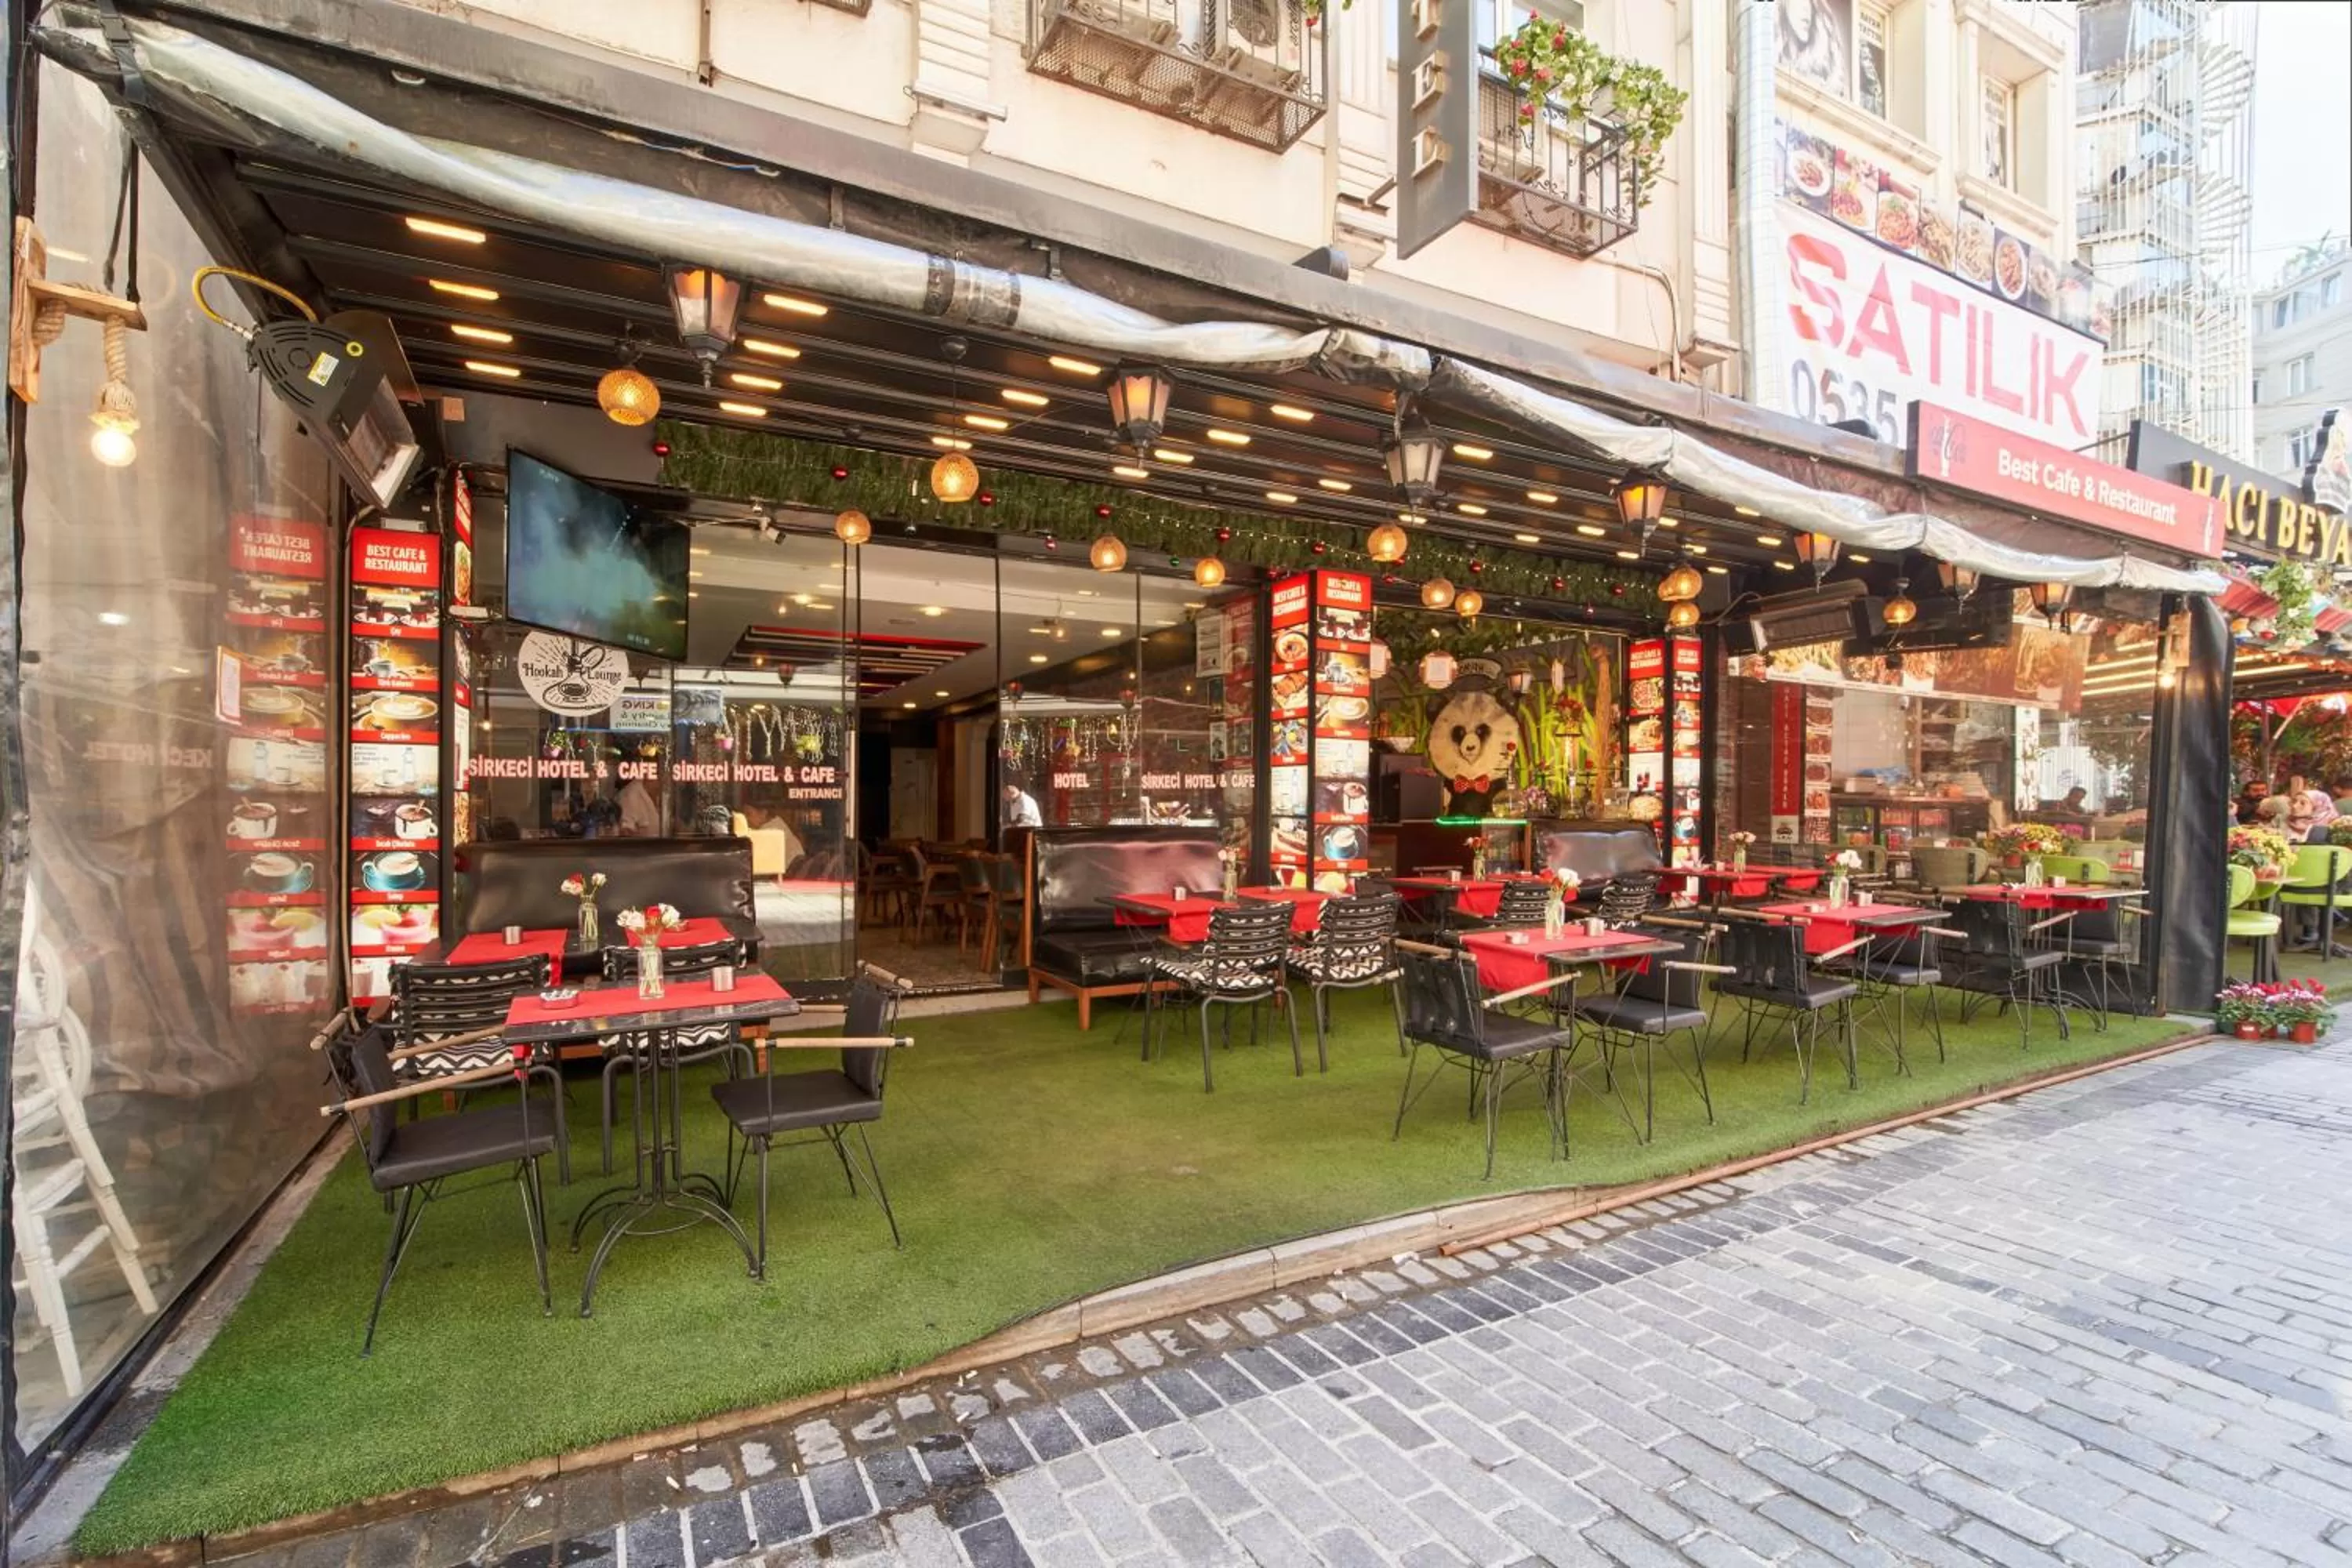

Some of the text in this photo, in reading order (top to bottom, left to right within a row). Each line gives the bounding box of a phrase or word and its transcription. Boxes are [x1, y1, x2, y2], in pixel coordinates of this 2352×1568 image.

[1787, 233, 2090, 437] SATILIK
[1791, 359, 1900, 448] 0535
[1998, 448, 2038, 485] Best
[2042, 464, 2081, 497] Cafe
[2084, 477, 2096, 503] &
[2098, 481, 2176, 526] Restaurant
[2192, 459, 2269, 540] HACI
[366, 544, 426, 561] BEST CAFE &
[364, 558, 428, 575] RESTAURANT
[521, 663, 622, 685] Hookah Lounge
[470, 754, 658, 780] SİRKECİ HOTEL & CAFE
[673, 760, 835, 783] SİRKECİ HOTEL & CAFE
[1054, 772, 1090, 789] HOTEL
[1142, 771, 1254, 789] SİRKECİ HOTEL & CAFE
